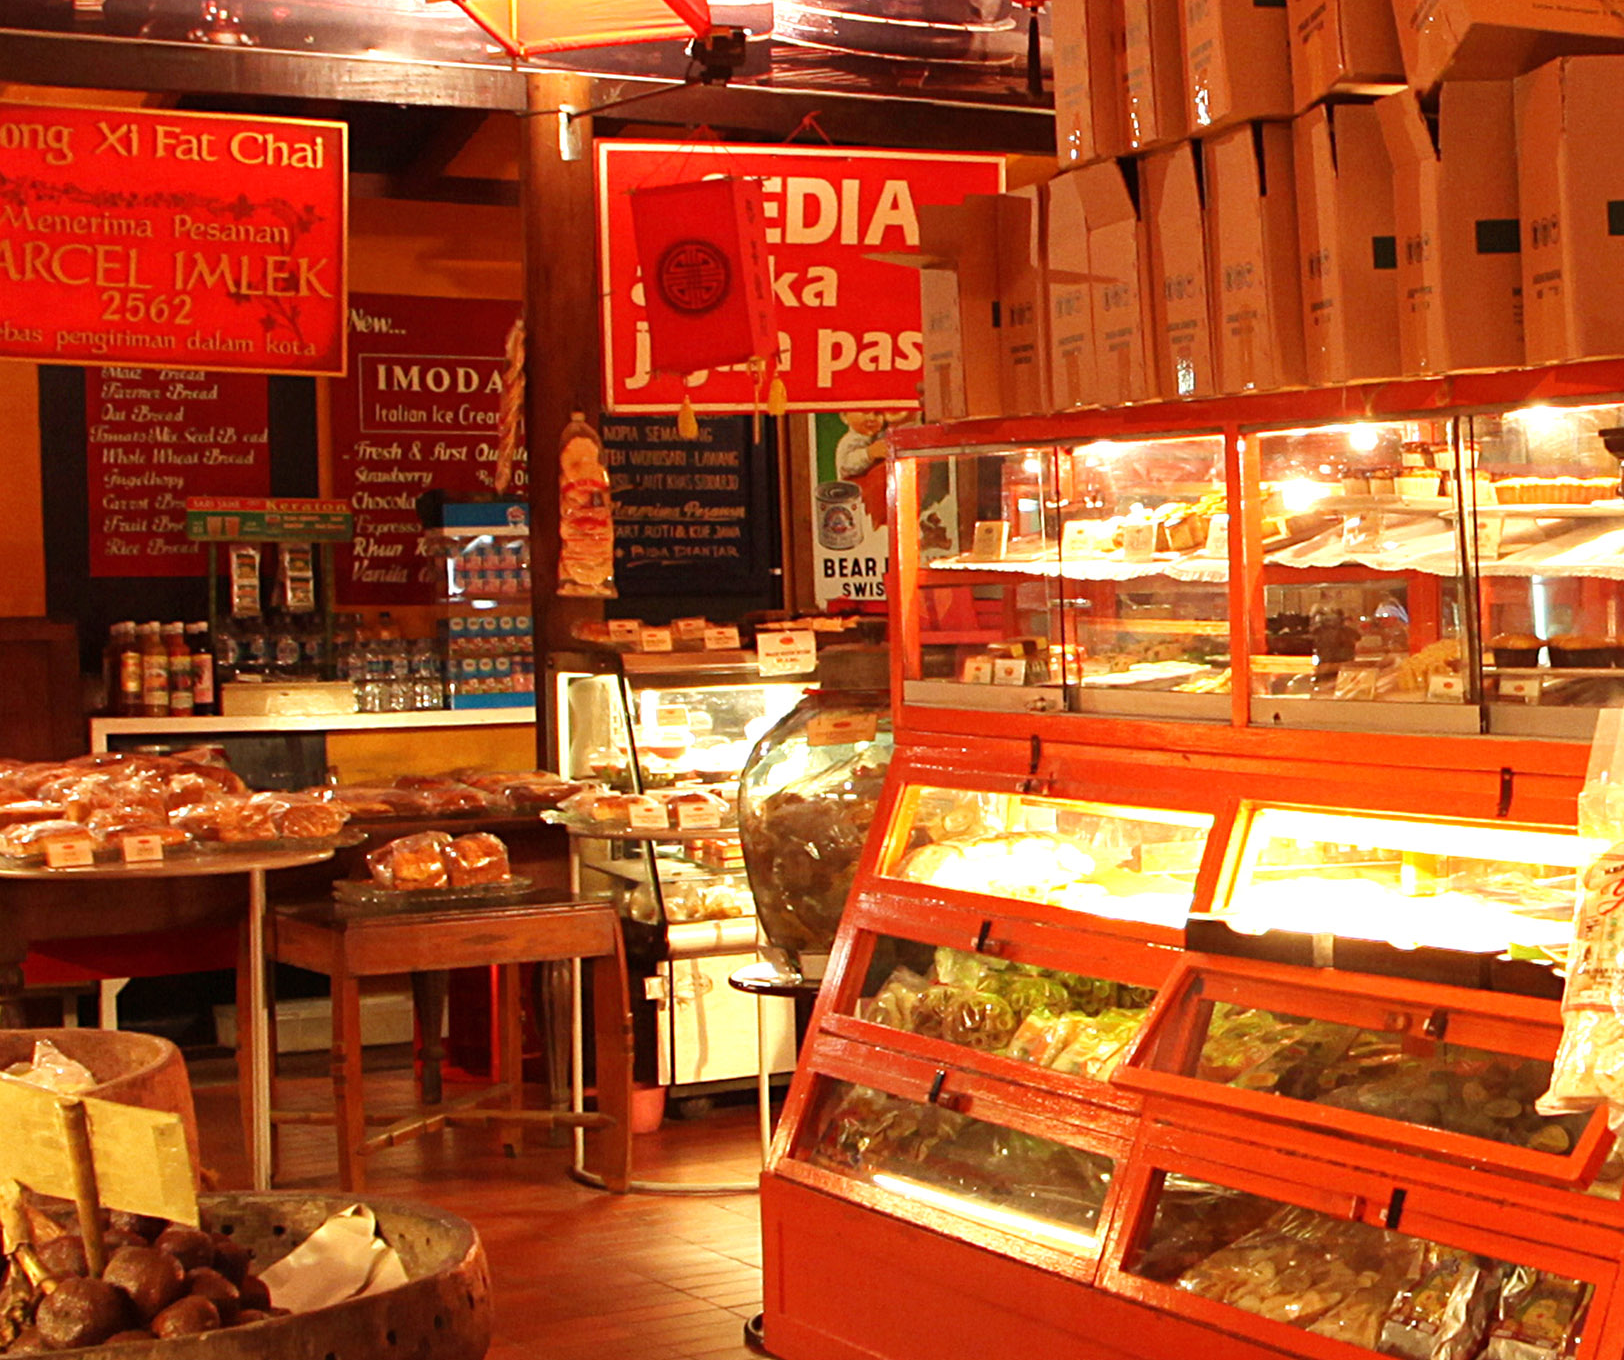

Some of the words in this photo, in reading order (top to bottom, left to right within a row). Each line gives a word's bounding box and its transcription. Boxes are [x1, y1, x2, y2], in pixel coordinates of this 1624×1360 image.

[95, 121, 139, 156] Xi
[155, 125, 221, 161] Fat
[230, 131, 325, 169] Chai
[701, 174, 920, 246] EDIA
[173, 213, 290, 244] Pesanan
[173, 251, 334, 299] IMLEK
[101, 290, 193, 325] 2562
[56, 327, 177, 355] pengiriman
[186, 327, 255, 354] dalam
[266, 332, 317, 357] kota
[816, 328, 923, 389] pas
[166, 383, 219, 400] Bread
[131, 404, 184, 422] Bread
[376, 404, 426, 423] Italian
[433, 405, 454, 424] Ice
[203, 448, 254, 465] Bread
[354, 441, 402, 461] Fresh
[352, 492, 417, 511] Chocola
[823, 557, 877, 580] BEAR
[842, 582, 886, 599] SWIS
